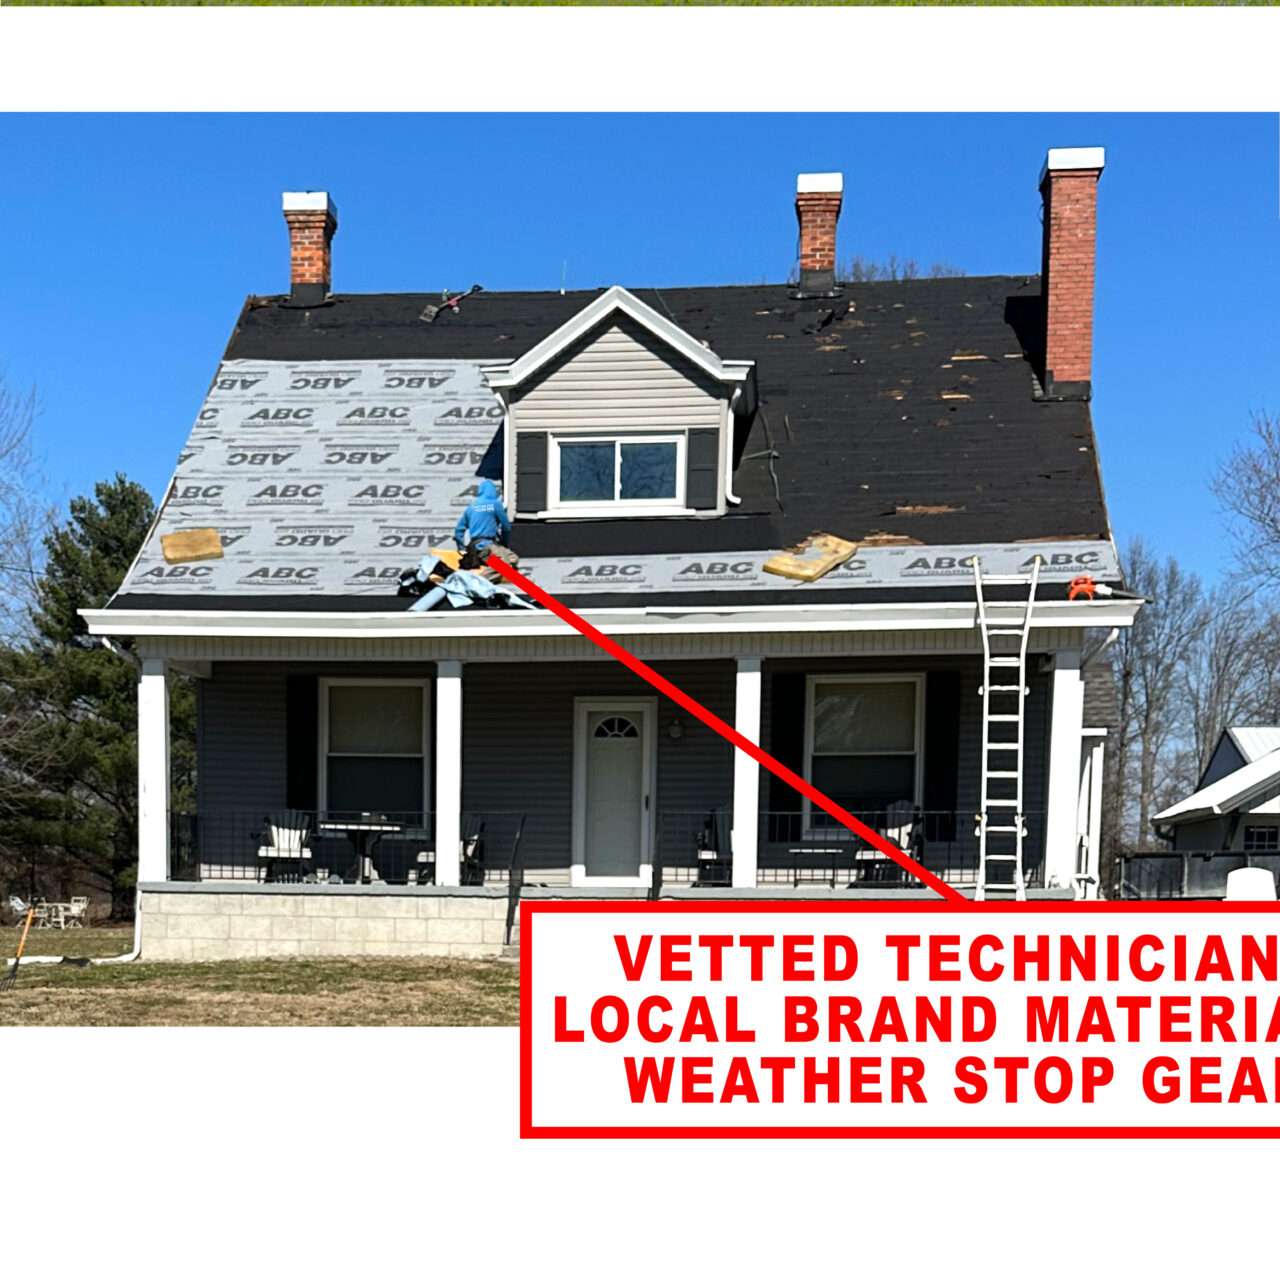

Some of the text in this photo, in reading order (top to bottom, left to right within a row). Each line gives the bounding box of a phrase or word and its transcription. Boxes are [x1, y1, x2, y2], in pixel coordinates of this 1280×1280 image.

[217, 378, 261, 390] AB
[290, 377, 355, 390] ABC
[384, 376, 449, 389] ABC
[247, 407, 314, 420] ABC
[345, 406, 409, 419] ABC
[227, 452, 294, 466] ABC
[325, 451, 393, 465] ABC
[253, 484, 324, 498] ABC
[354, 484, 425, 499] ABC
[275, 534, 348, 547] ABC
[379, 534, 452, 548] ABC
[140, 566, 213, 578] ABC
[245, 567, 319, 579] ABC
[352, 566, 402, 579] AB
[567, 564, 642, 578] ABC
[679, 561, 754, 575] ABC
